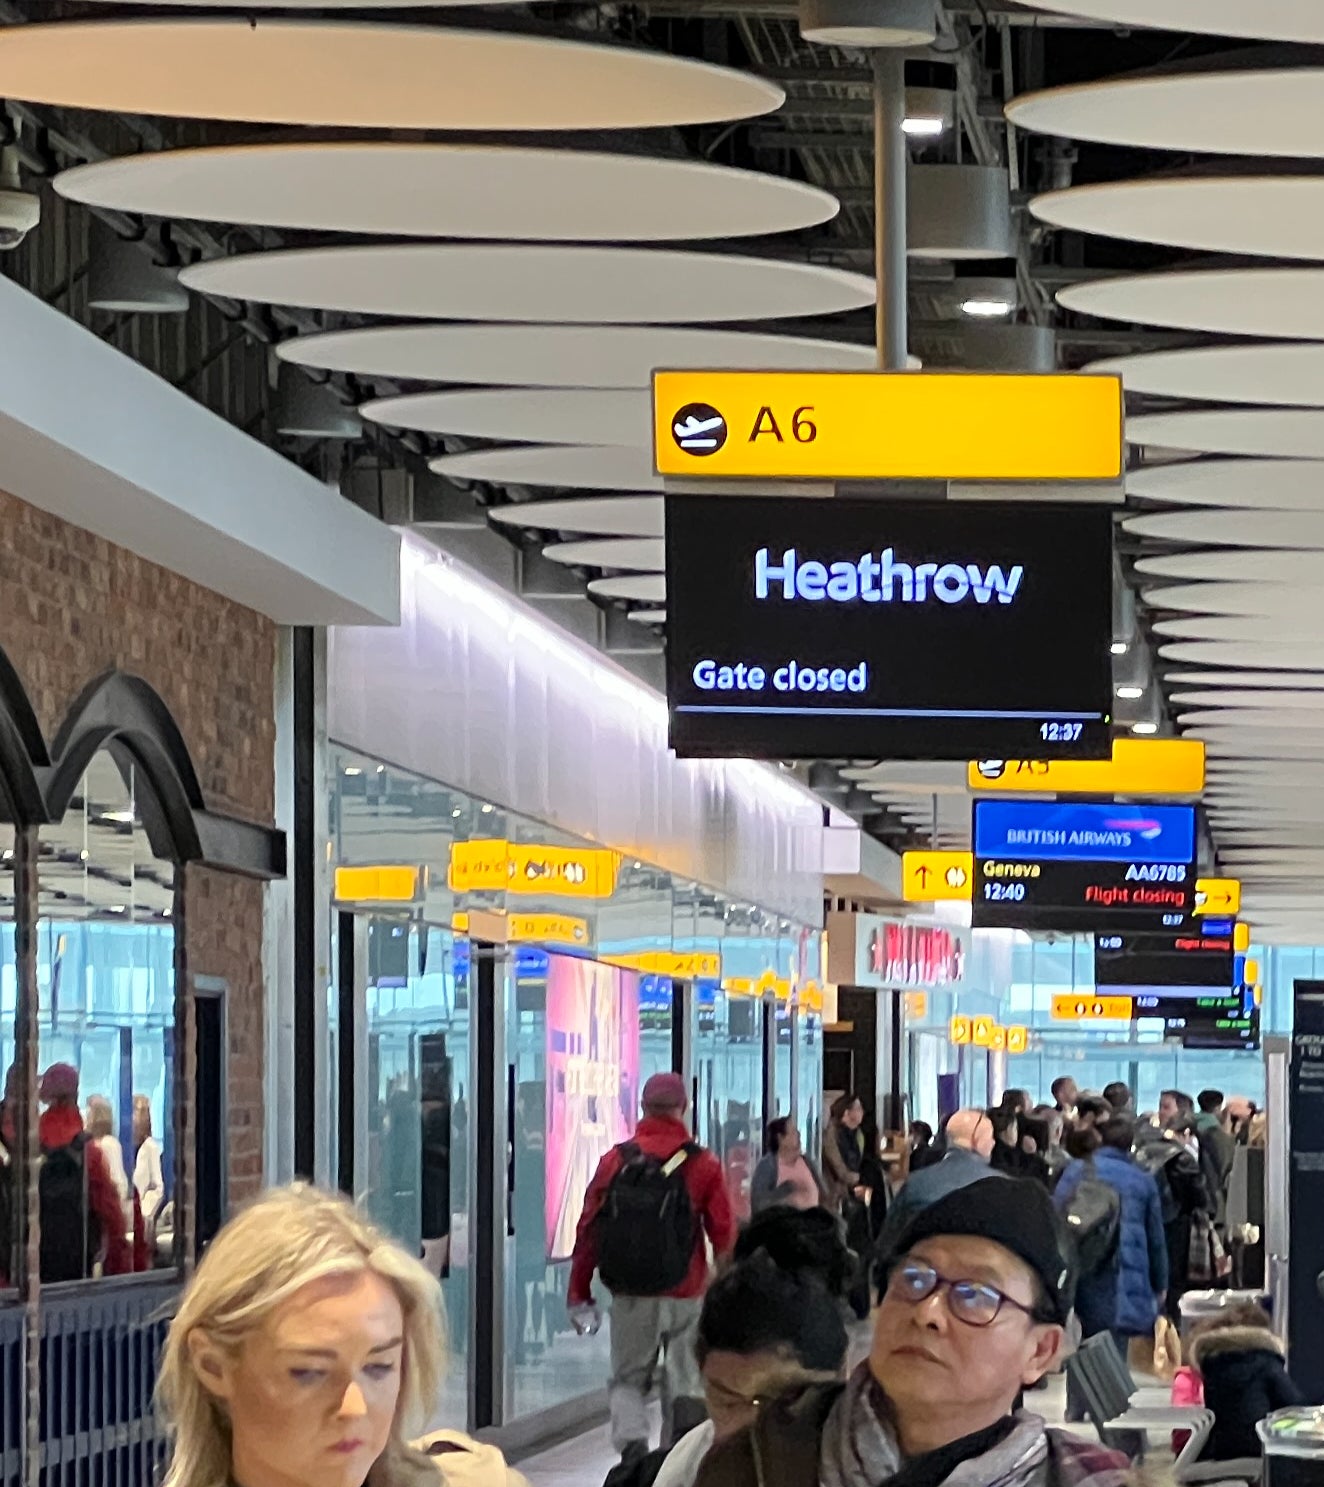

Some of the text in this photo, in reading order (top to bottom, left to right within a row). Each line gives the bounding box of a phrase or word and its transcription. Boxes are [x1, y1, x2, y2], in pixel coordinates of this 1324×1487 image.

[748, 405, 818, 443] A6
[754, 547, 1024, 604] Heathrow
[692, 660, 868, 692] Gate closed
[1040, 722, 1082, 741] 12:37
[1007, 829, 1131, 847] BRITISH AIRWAYS
[983, 860, 1040, 878] Geneva
[984, 883, 1185, 905] 12:40 Flight closing
